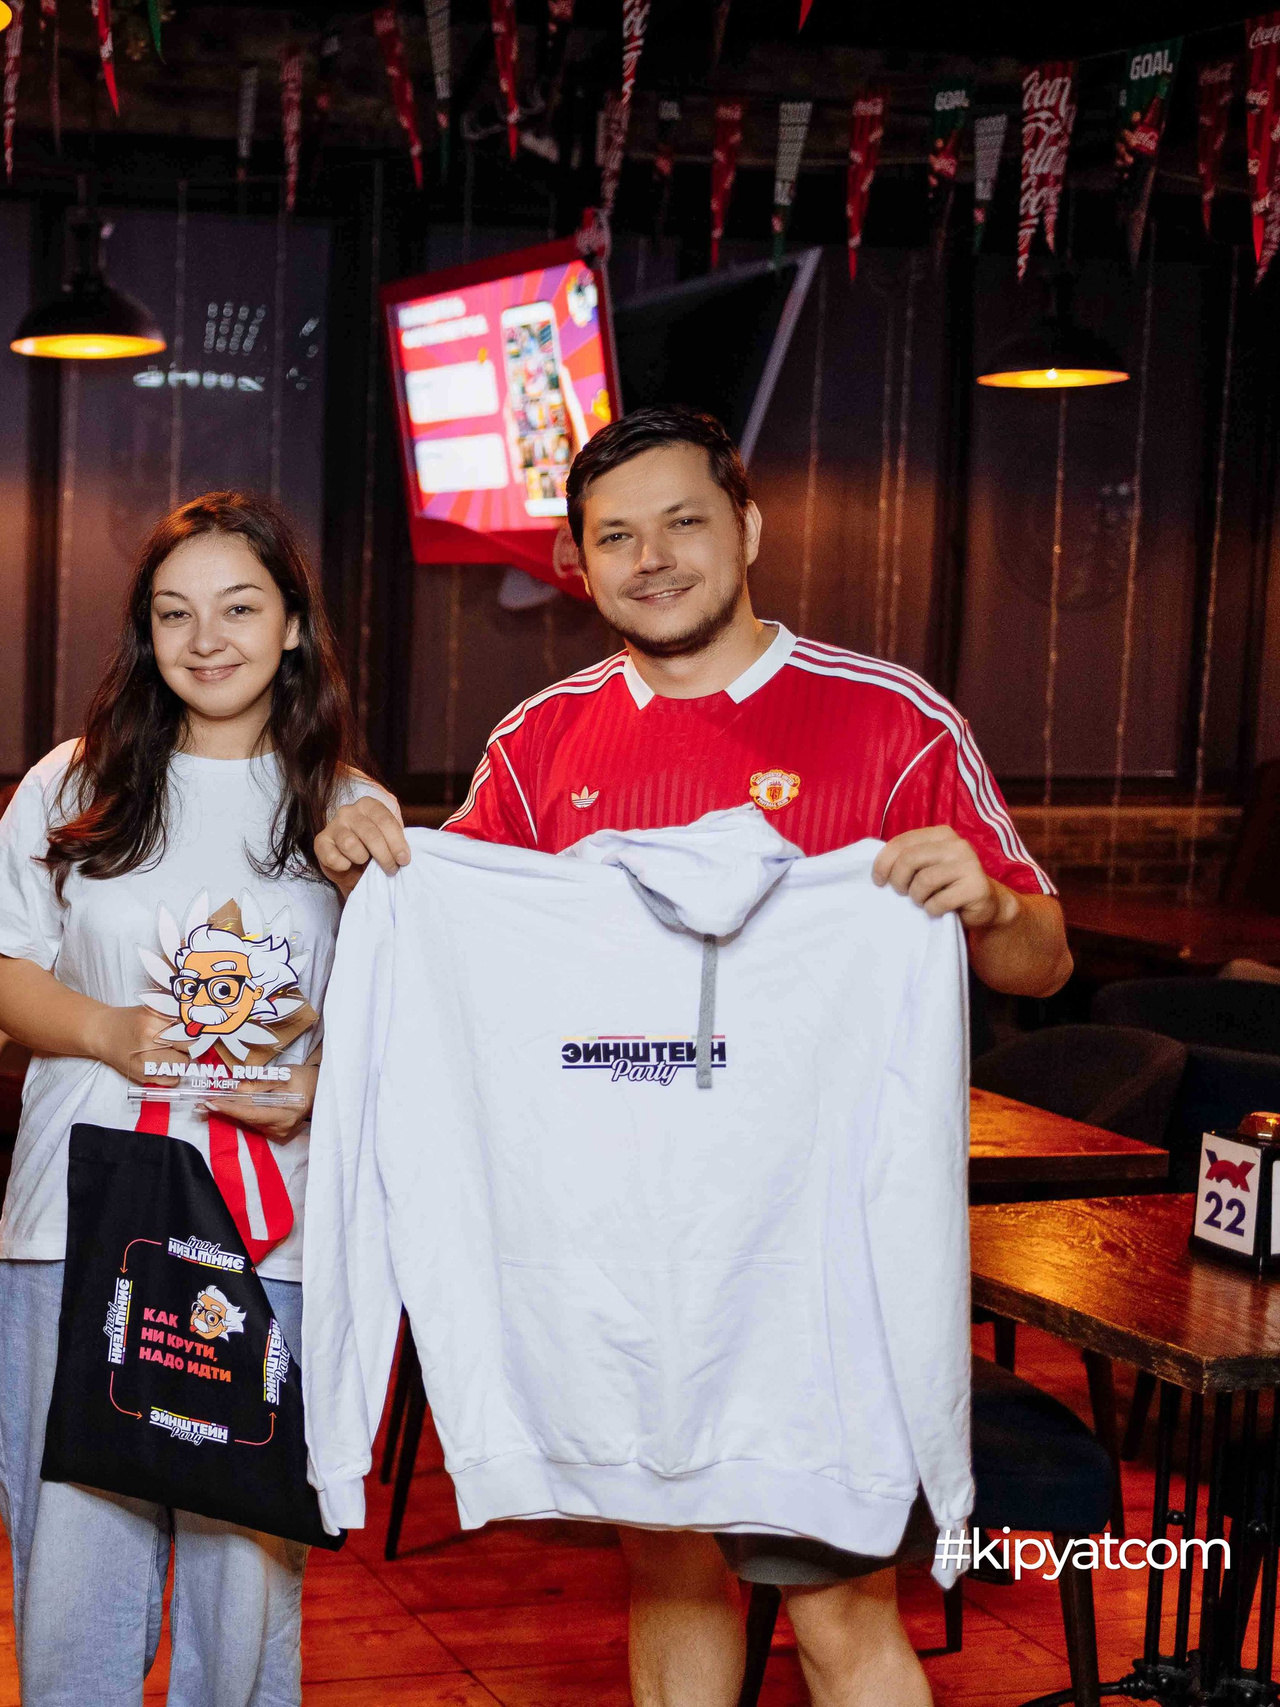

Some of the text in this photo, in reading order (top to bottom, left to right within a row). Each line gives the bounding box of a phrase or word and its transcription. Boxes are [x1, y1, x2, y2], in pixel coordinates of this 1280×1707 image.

[1130, 49, 1173, 80] GOAL
[144, 1061, 291, 1081] BANANA RULES
[191, 1079, 240, 1089] ШЫМКЕНТ
[611, 1058, 679, 1087] Party
[1203, 1190, 1246, 1237] 22
[187, 1235, 221, 1256] Party
[103, 1302, 119, 1336] Party
[143, 1307, 179, 1328] КАК
[141, 1327, 218, 1362] НИ КРУТИ,
[139, 1346, 232, 1383] НАДО ИДТИ
[170, 1425, 204, 1446] Party
